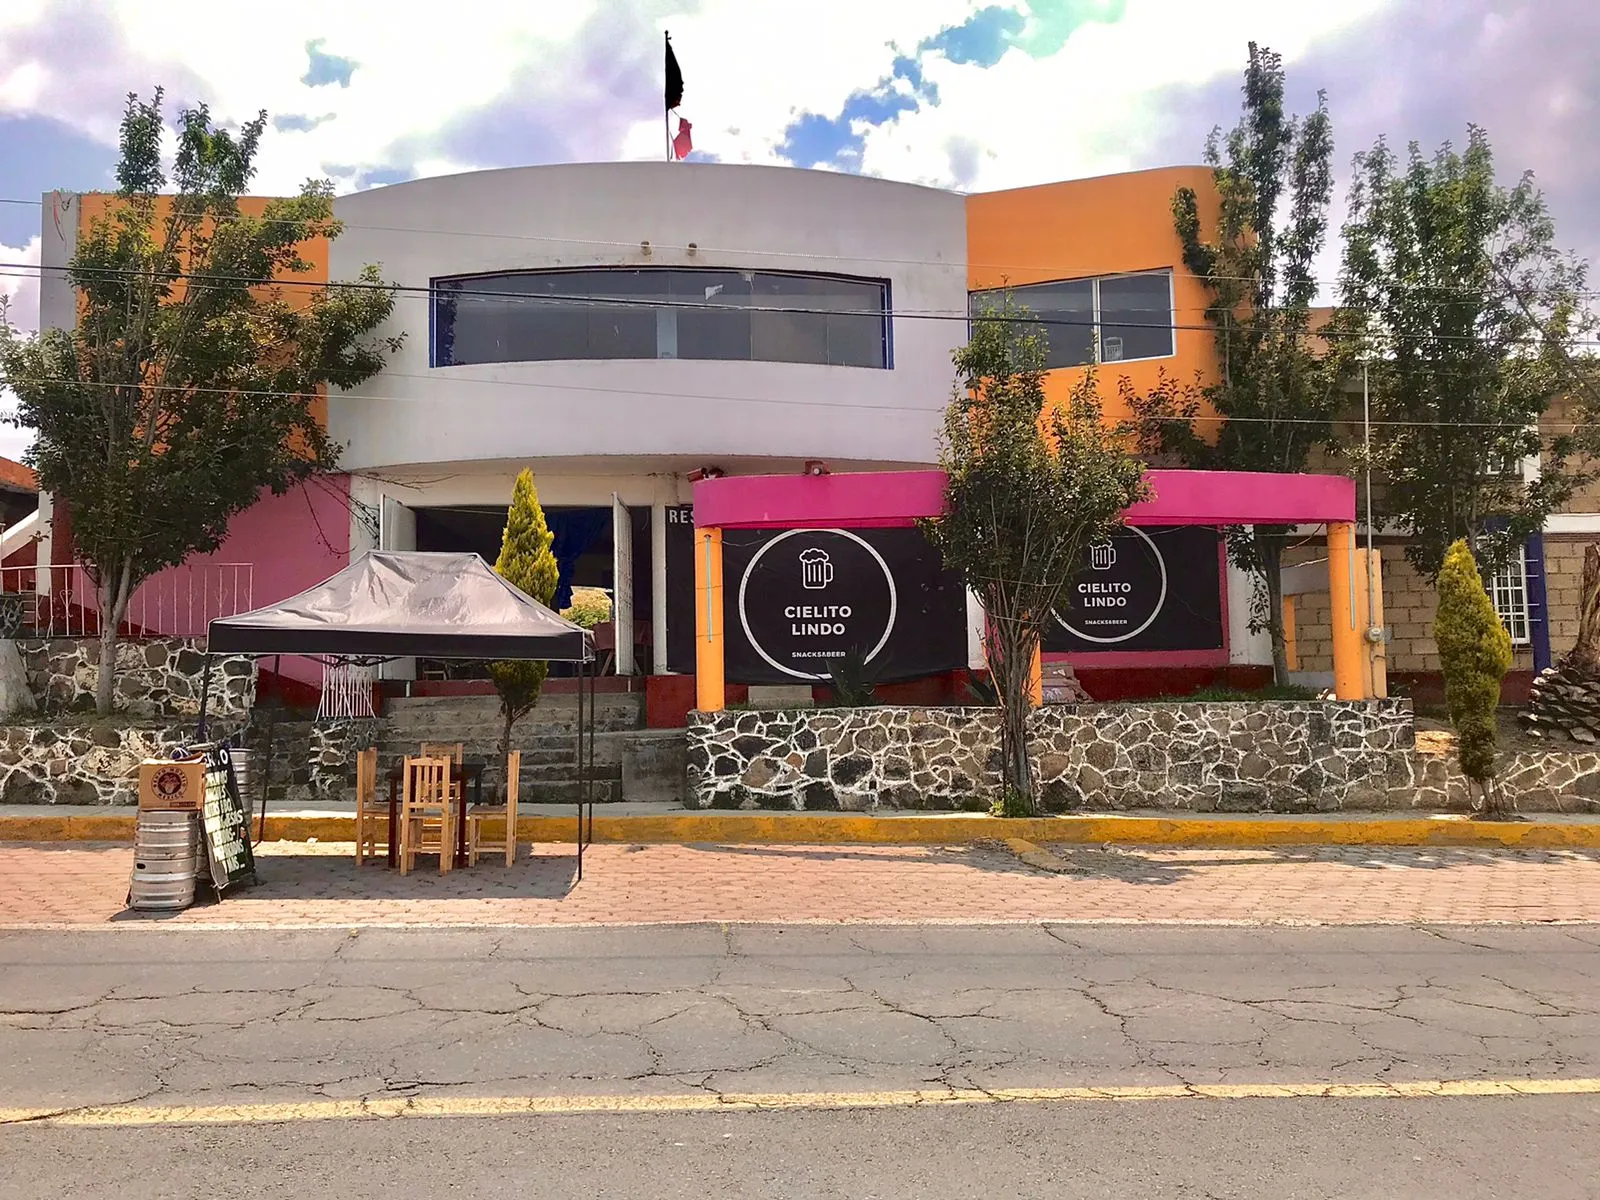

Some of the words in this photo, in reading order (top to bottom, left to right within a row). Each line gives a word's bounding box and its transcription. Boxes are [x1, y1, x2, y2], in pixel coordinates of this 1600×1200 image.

[1077, 582, 1132, 593] CIELITO
[1083, 597, 1127, 607] LINDO
[784, 605, 852, 618] CIELITO
[791, 623, 846, 636] LINDO
